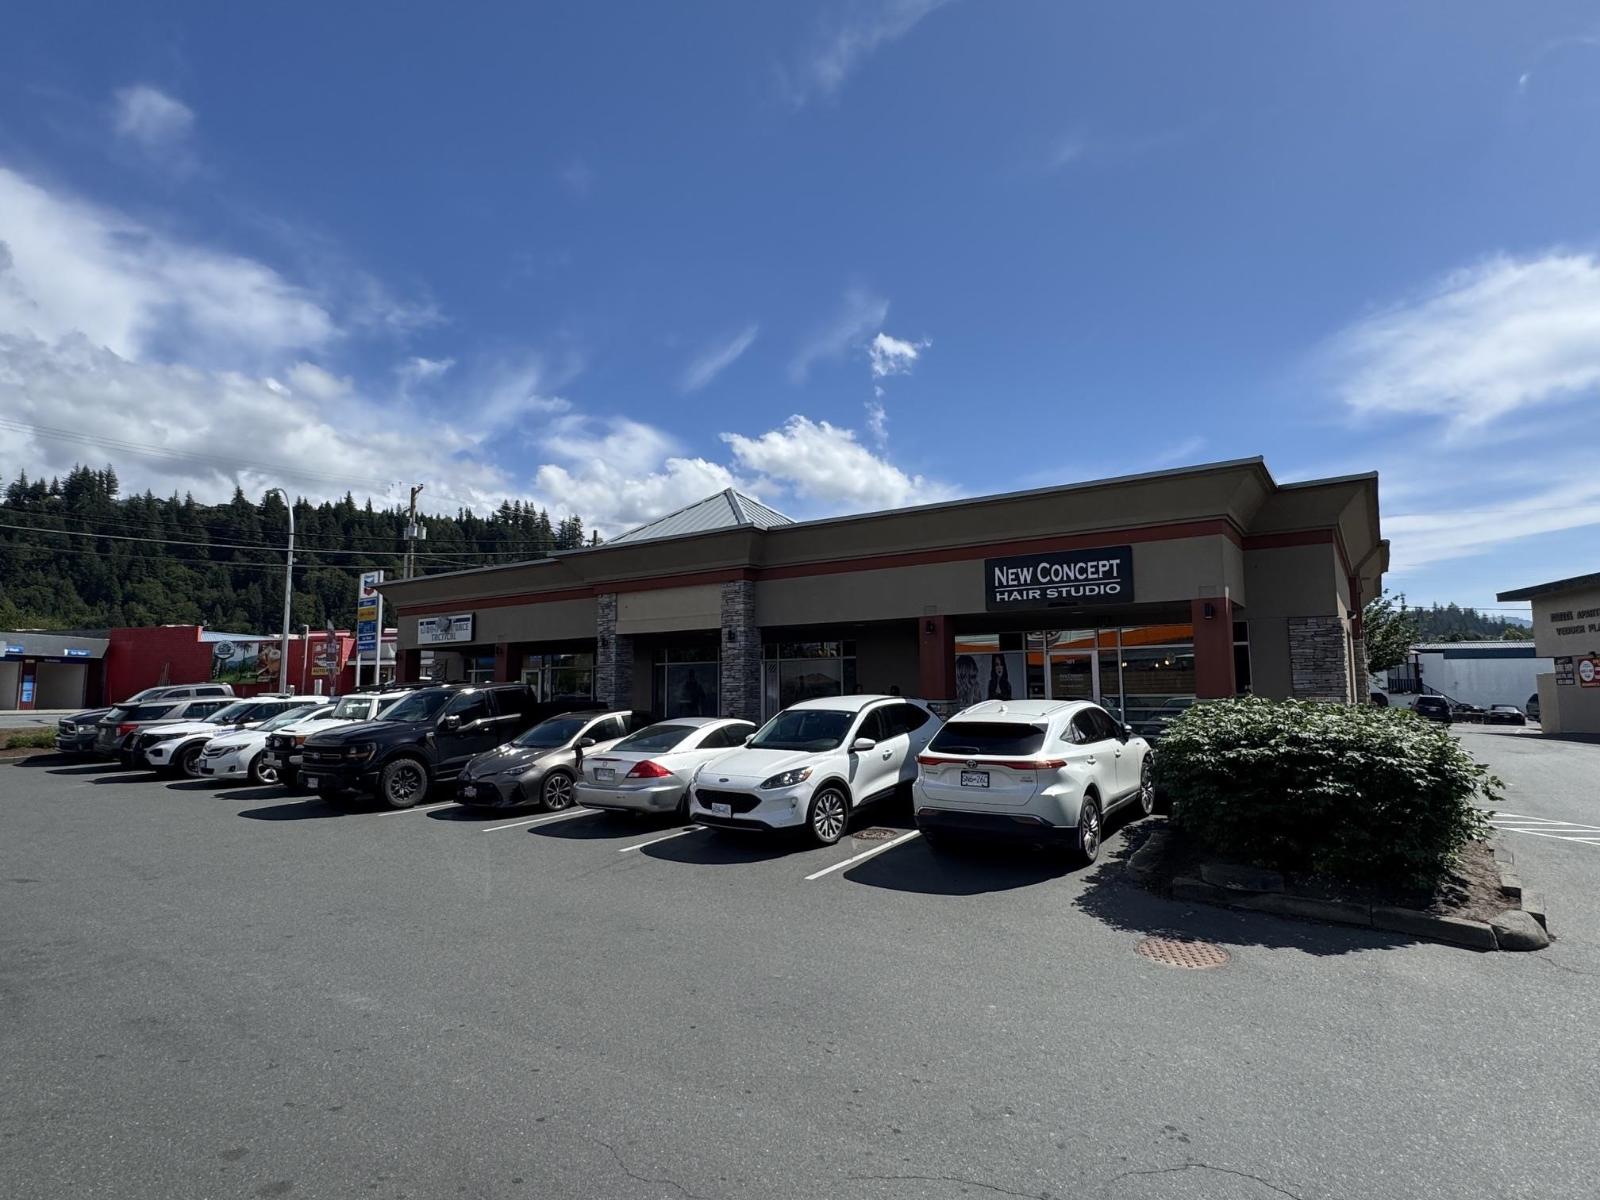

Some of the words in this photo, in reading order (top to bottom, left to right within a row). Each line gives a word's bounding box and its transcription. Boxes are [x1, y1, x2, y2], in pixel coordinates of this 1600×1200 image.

[994, 566, 1033, 587] NEW
[1036, 558, 1121, 583] CONCEPT
[996, 589, 1041, 602] HAIR
[1046, 583, 1121, 599] STUDIO
